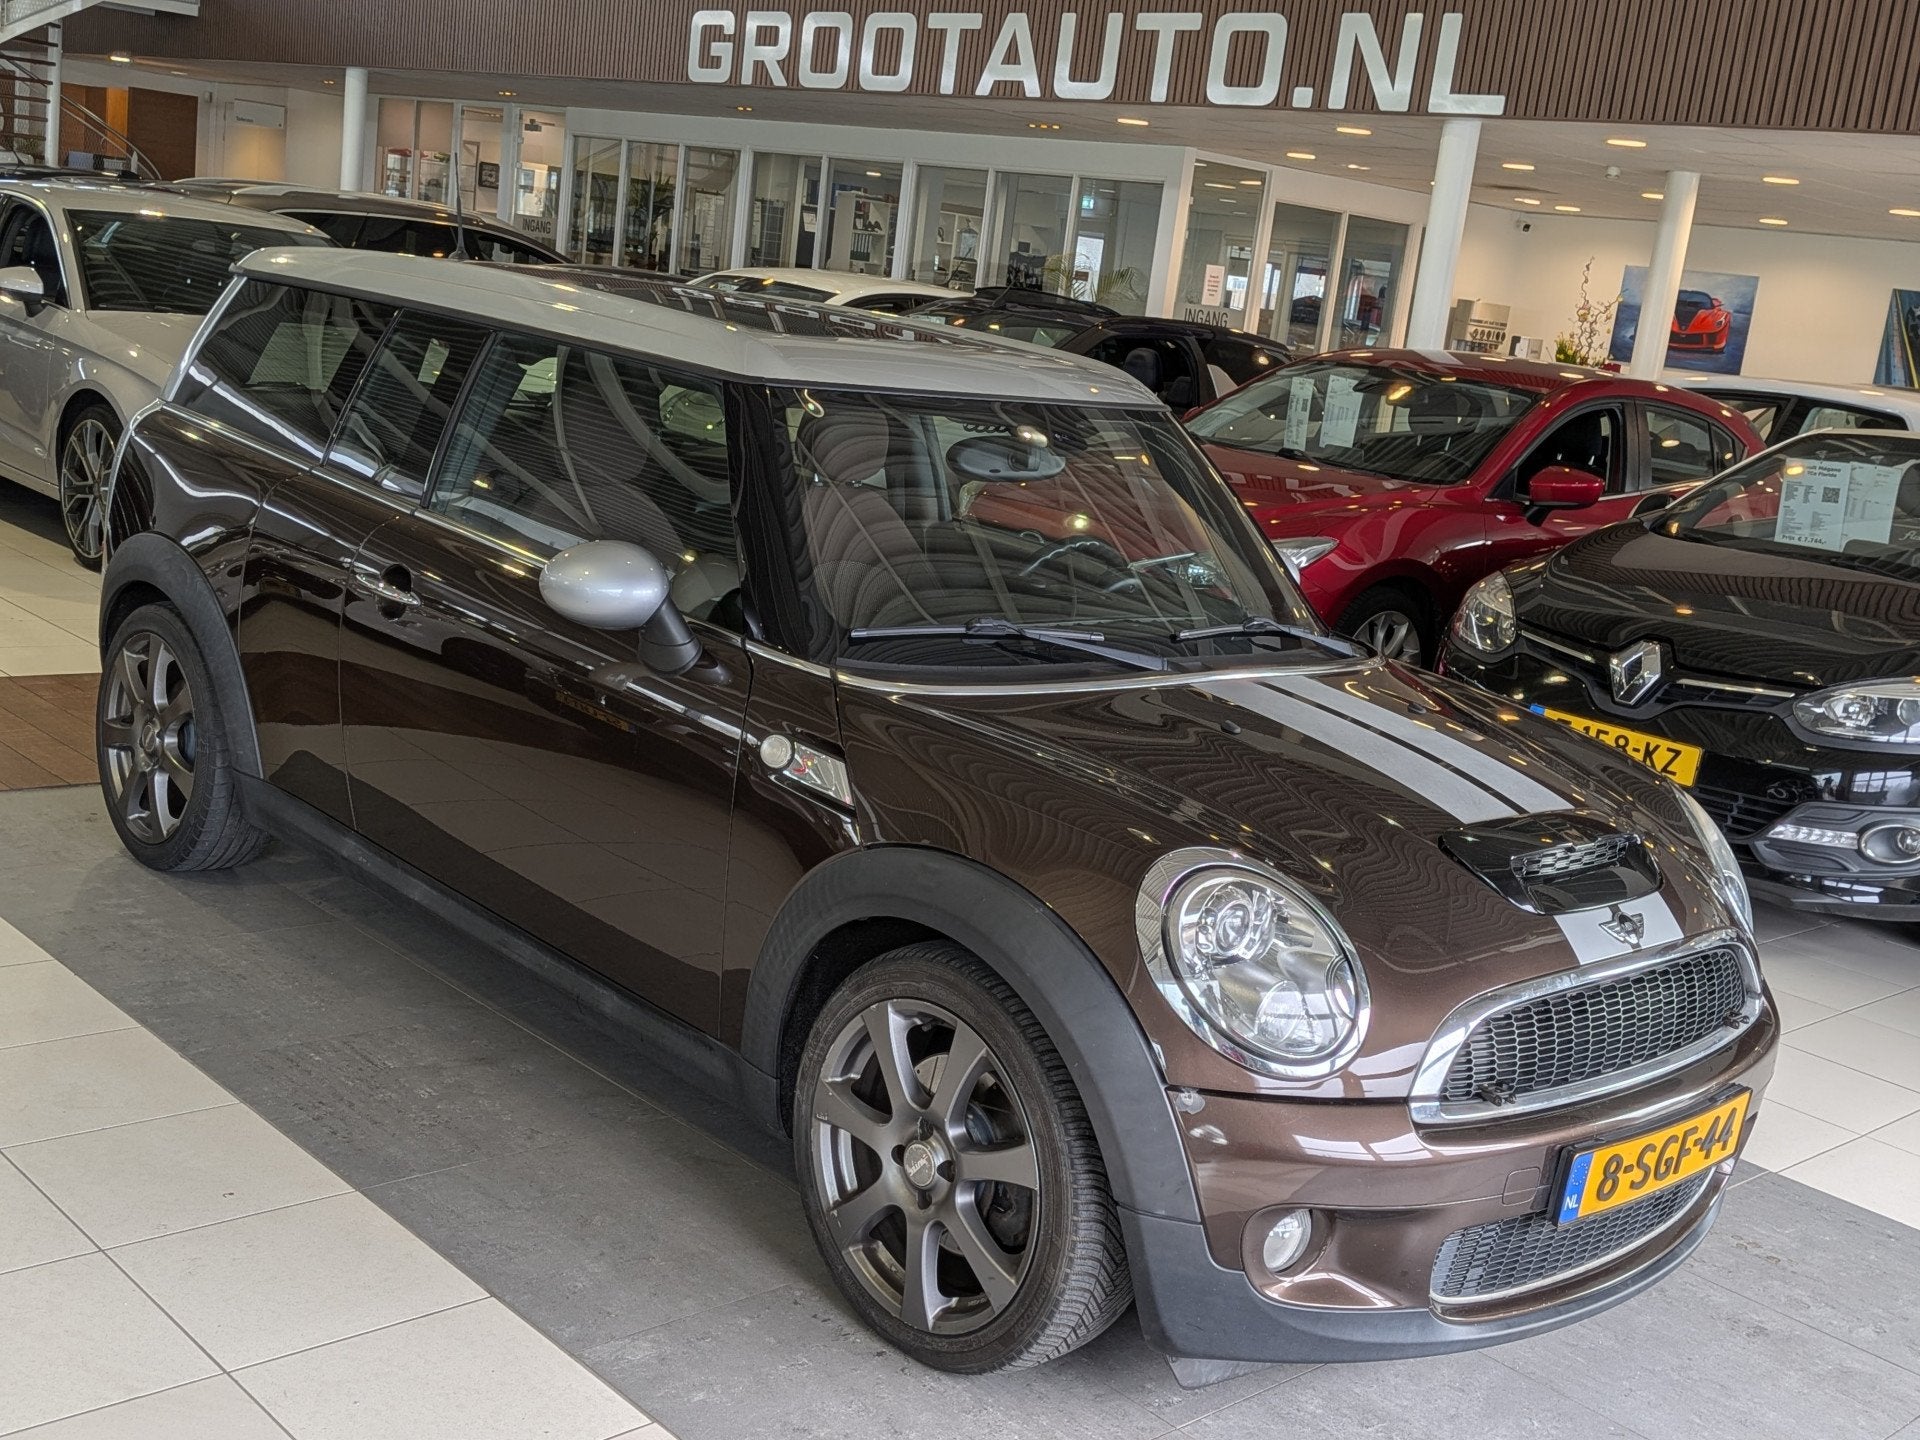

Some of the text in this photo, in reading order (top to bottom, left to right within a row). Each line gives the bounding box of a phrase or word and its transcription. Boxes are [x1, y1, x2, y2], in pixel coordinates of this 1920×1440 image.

[687, 10, 1506, 116] GROOTAUTO.NL
[522, 218, 551, 234] INGANG
[1184, 308, 1228, 328] INGANG
[1596, 1107, 1738, 1202] 8-SGF-44
[1564, 1194, 1579, 1211] NL
